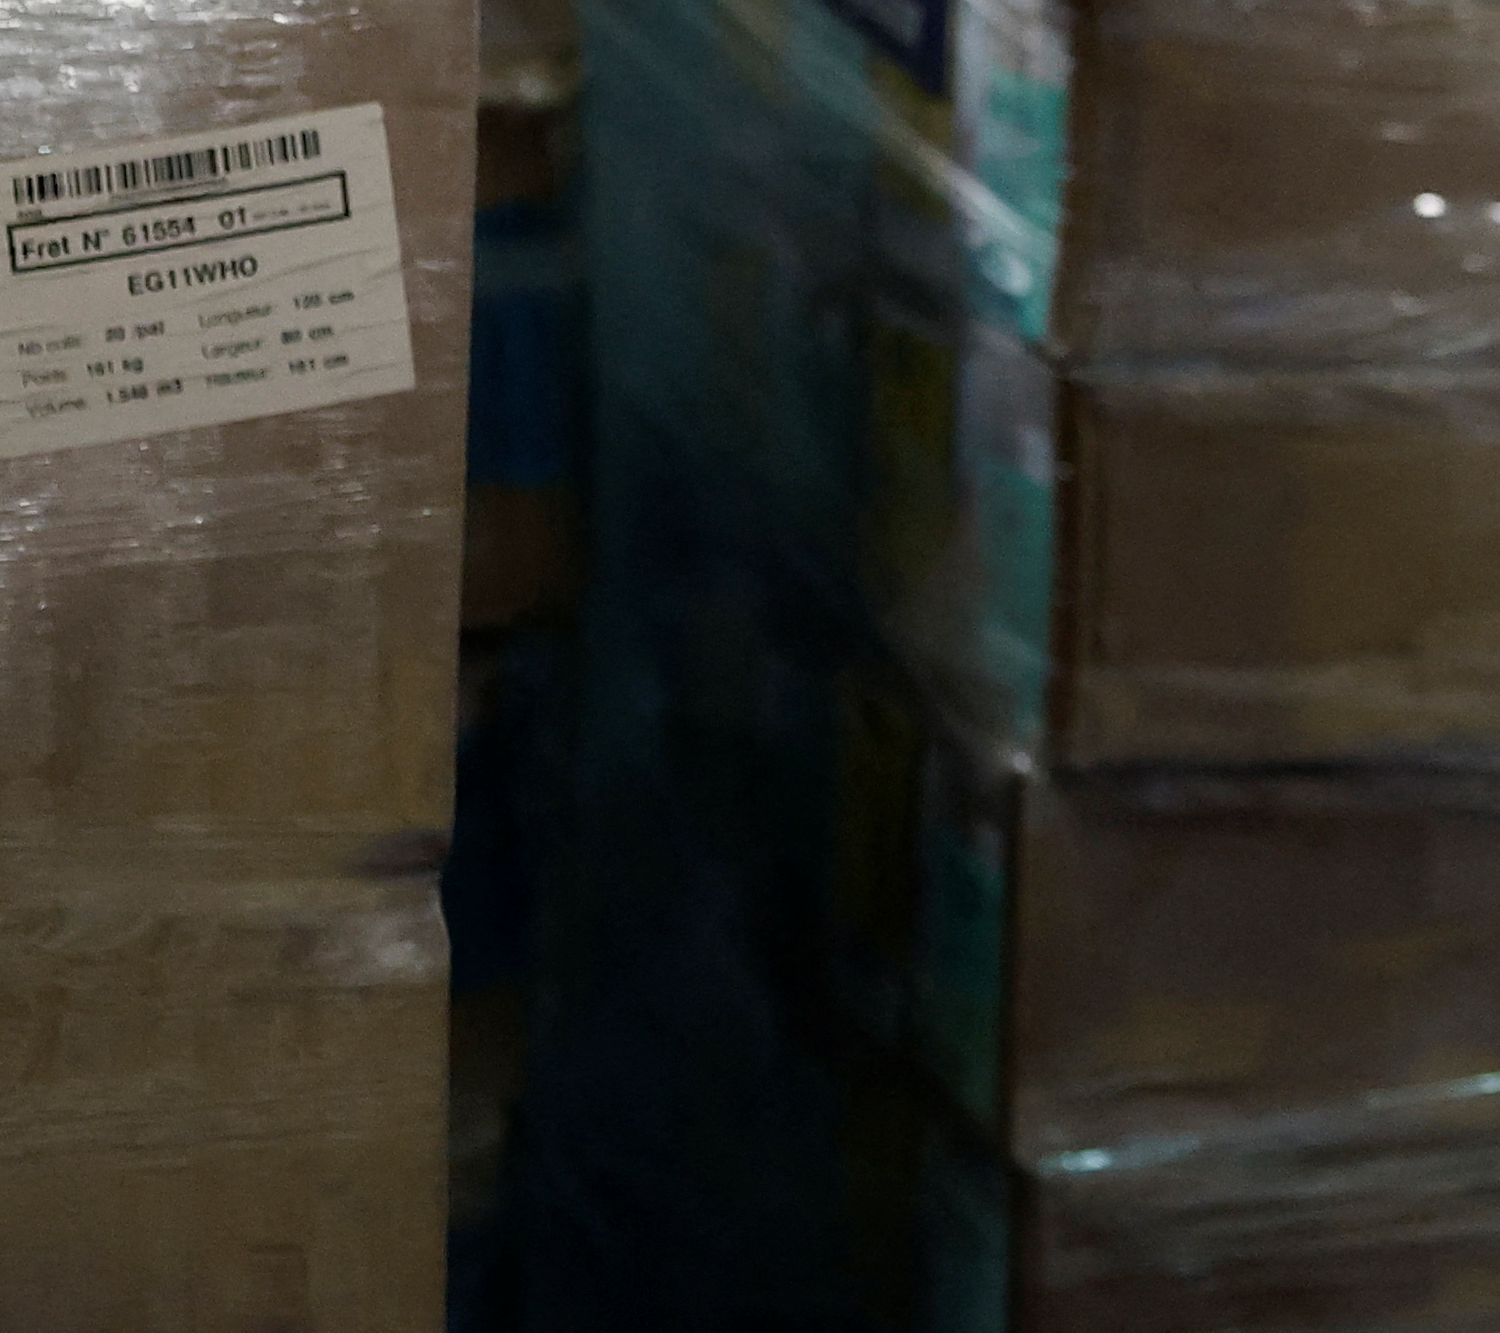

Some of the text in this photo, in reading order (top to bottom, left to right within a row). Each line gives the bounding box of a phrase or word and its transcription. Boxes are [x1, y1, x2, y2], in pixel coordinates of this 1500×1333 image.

[21, 235, 71, 261] Fret
[121, 216, 198, 247] 61554
[217, 206, 247, 231] 01
[127, 254, 259, 296] EG11WHO
